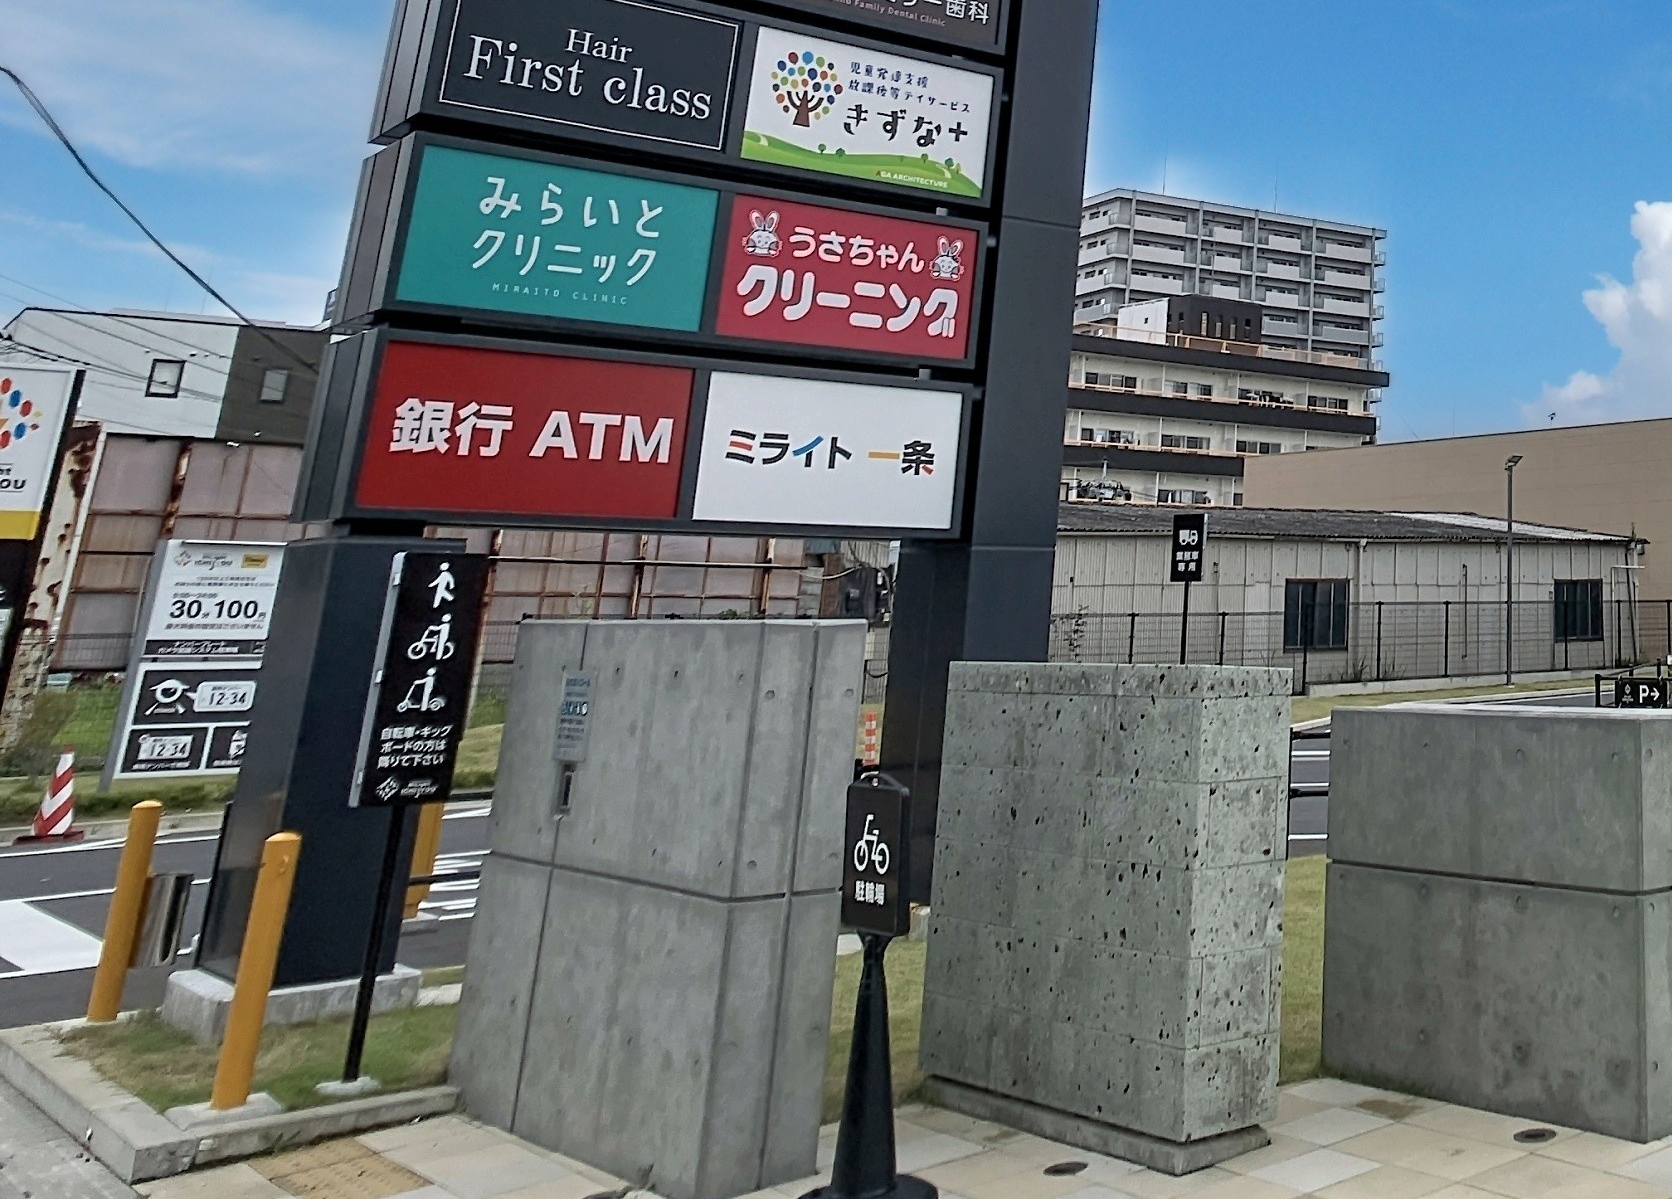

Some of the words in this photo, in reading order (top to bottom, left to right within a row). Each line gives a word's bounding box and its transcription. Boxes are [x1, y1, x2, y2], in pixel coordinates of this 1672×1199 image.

[854, 0, 886, 14] Family
[888, 6, 918, 21] Dental
[920, 14, 946, 27] Clinic
[565, 28, 634, 64] Hair
[463, 34, 584, 98] First
[603, 63, 713, 121] class
[893, 173, 949, 189] ARCHITECTURE
[478, 175, 664, 239] みらいと
[470, 230, 657, 287] クリニック
[788, 225, 926, 275] うさちゃん
[492, 282, 560, 298] MIRAITO
[572, 291, 627, 305] CLINIC
[736, 263, 960, 339] クリーニング
[388, 396, 514, 457] 銀行
[529, 410, 675, 465] ATM
[725, 428, 854, 471] ミライト
[867, 440, 936, 476] 一条
[1639, 684, 1650, 704] P
[379, 738, 447, 754] ボードの方は
[854, 879, 886, 906] 駐輪場
